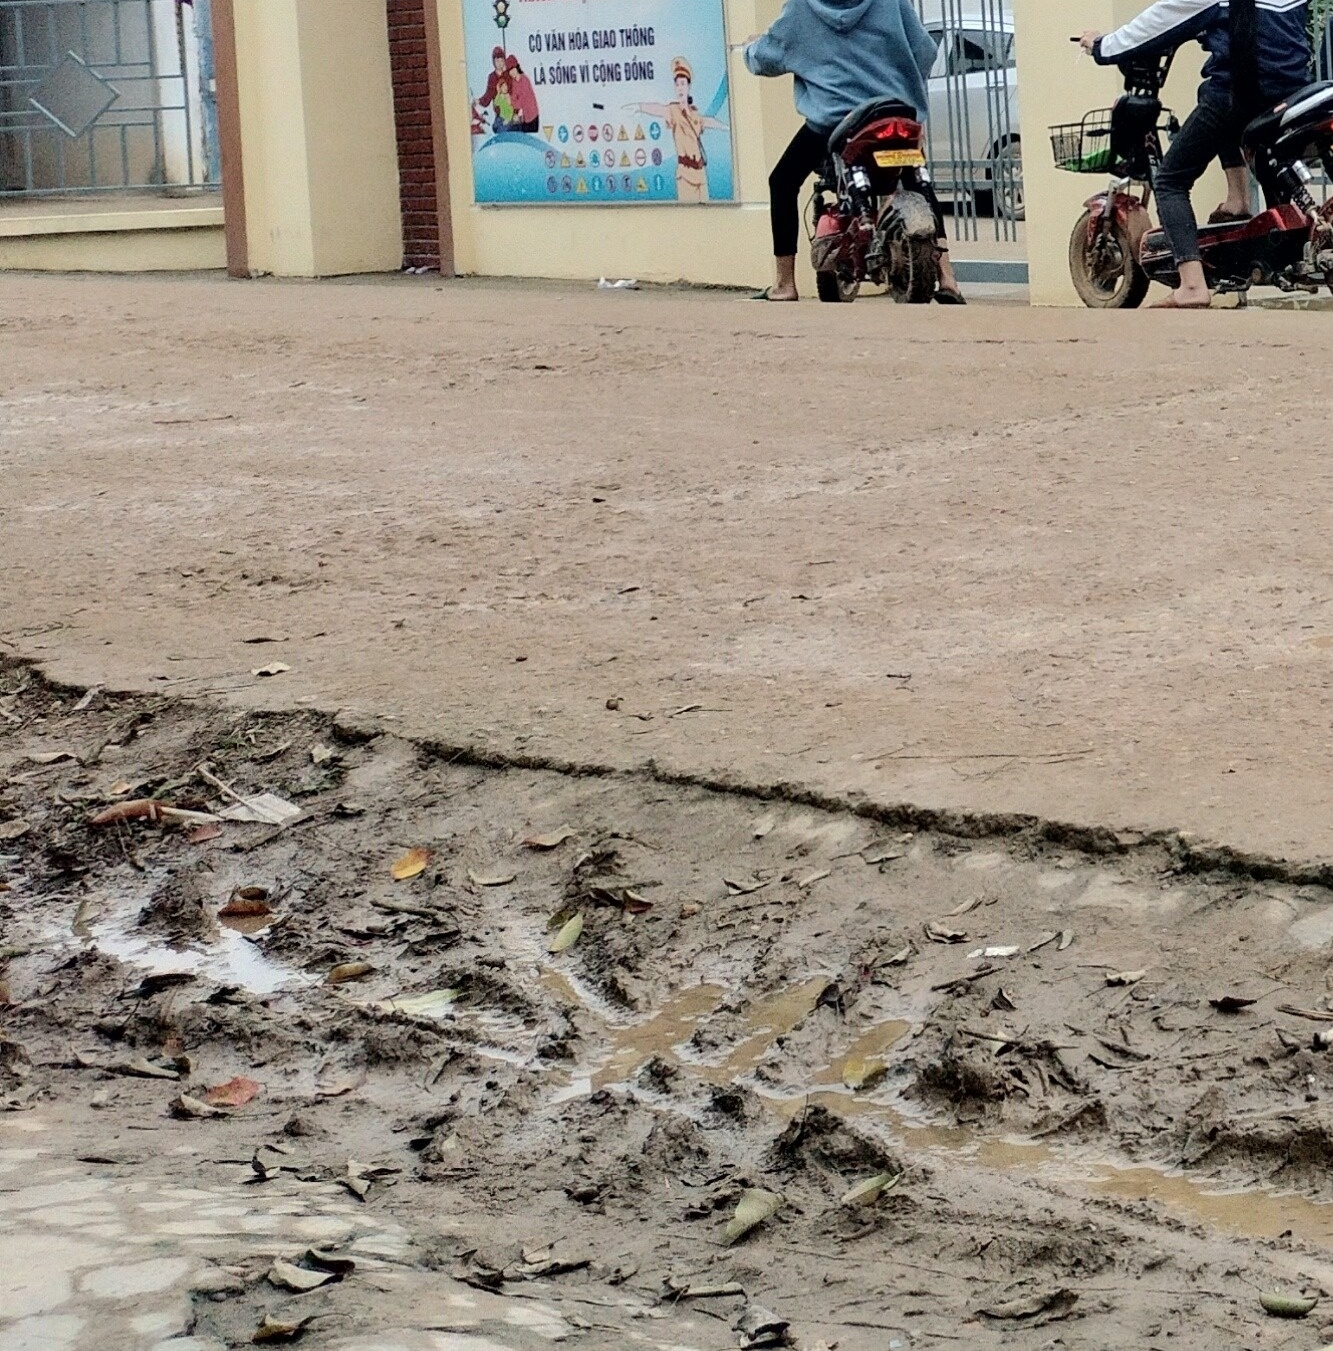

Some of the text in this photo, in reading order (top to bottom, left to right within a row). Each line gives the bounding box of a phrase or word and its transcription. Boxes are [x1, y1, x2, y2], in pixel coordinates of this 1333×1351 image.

[528, 23, 655, 53] CÓ VĂN HÓA GIAO THÔNG
[533, 62, 546, 86] LÀ
[548, 58, 577, 85] SỐNG
[579, 60, 590, 83] VÌ
[592, 59, 622, 87] CỘNG
